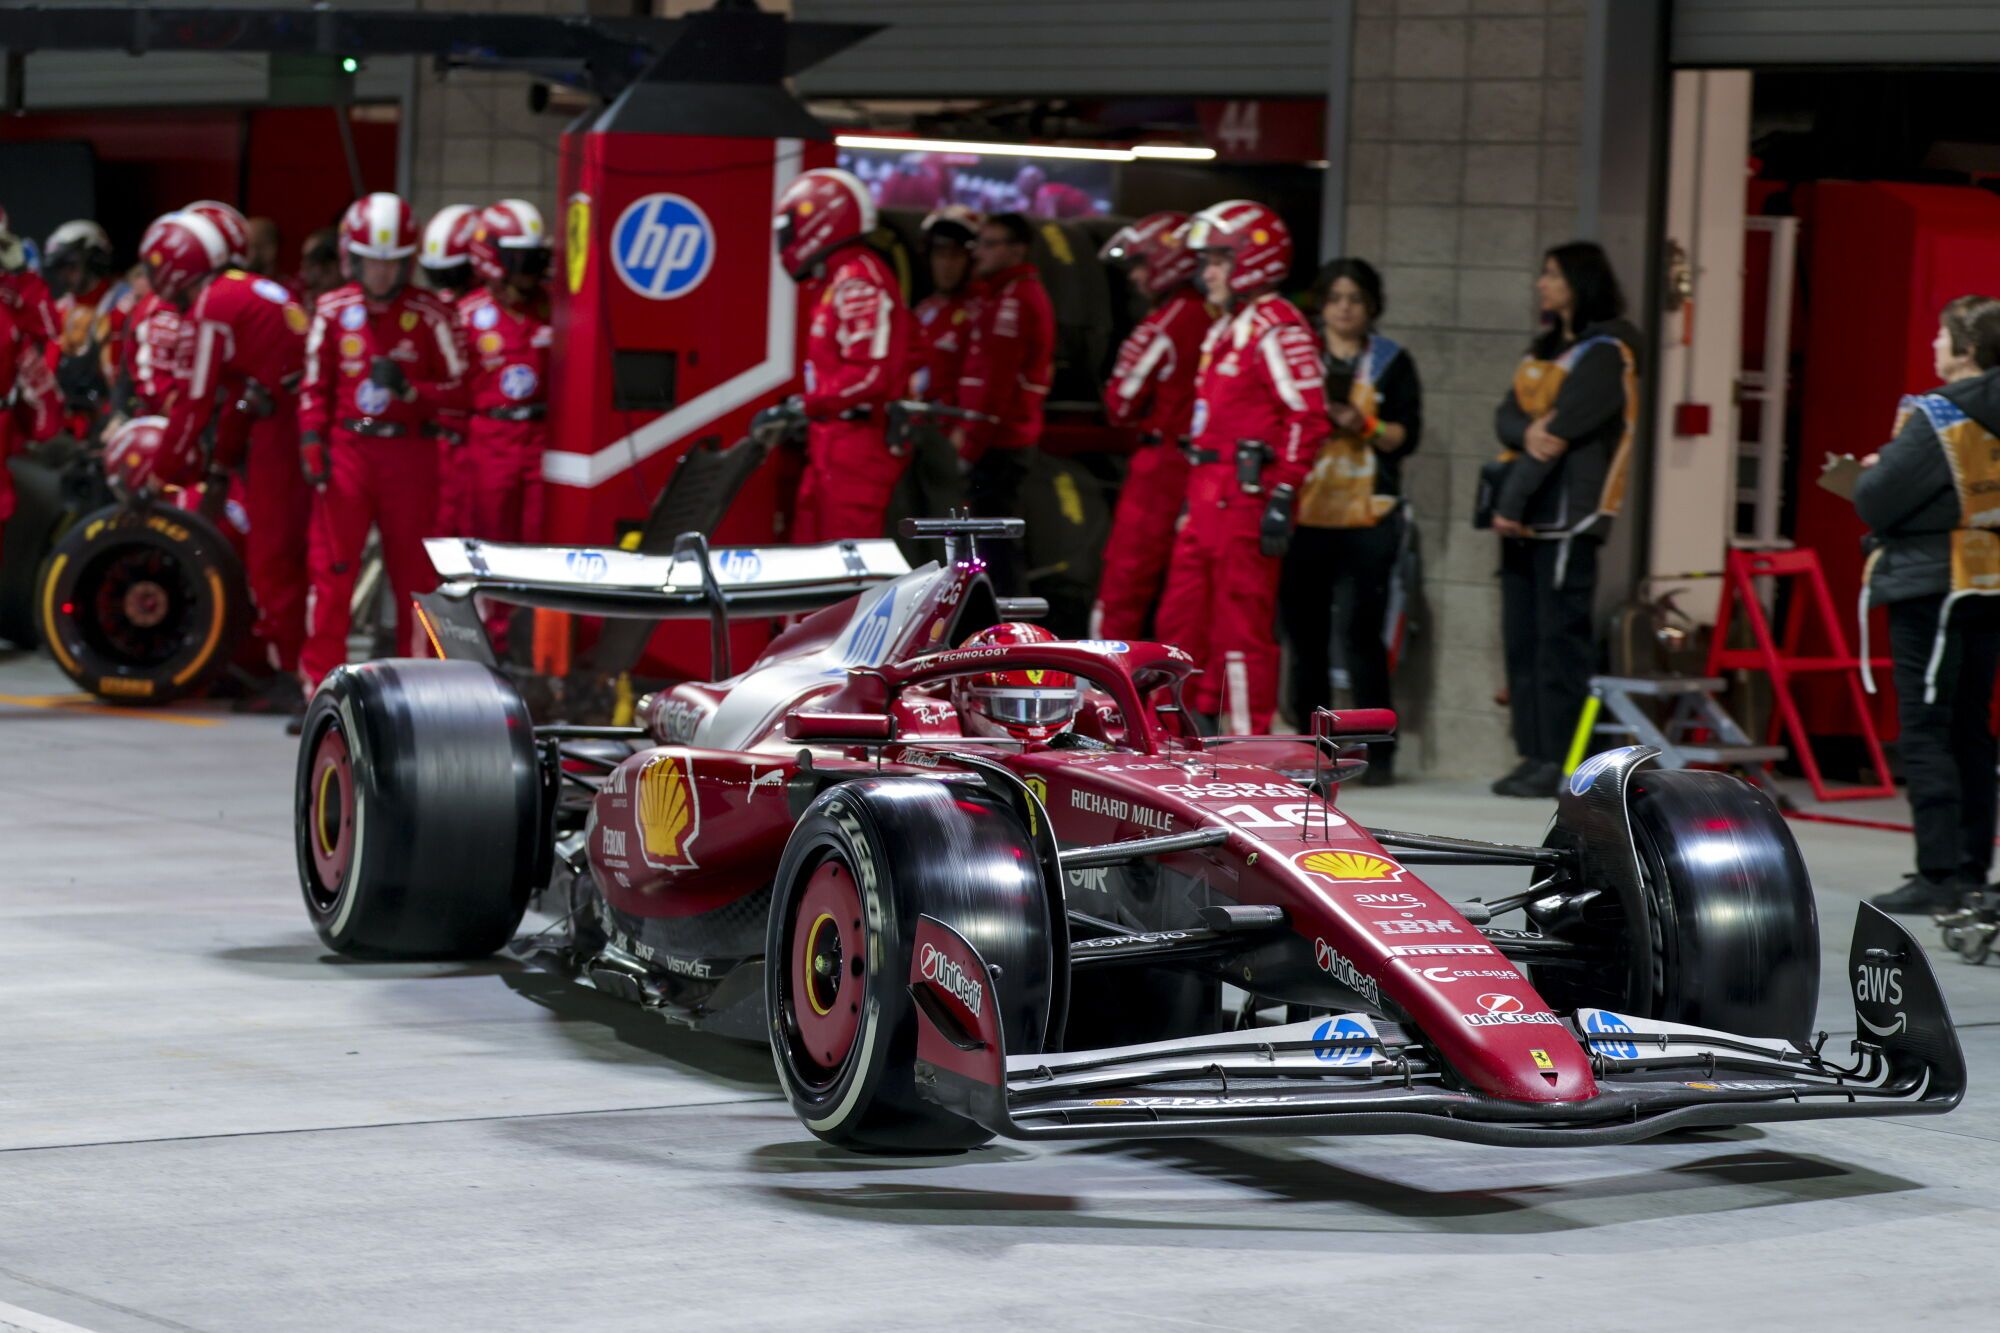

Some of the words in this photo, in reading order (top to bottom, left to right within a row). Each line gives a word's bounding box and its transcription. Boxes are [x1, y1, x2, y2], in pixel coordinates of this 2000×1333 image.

[1218, 101, 1260, 151] 44
[622, 194, 704, 298] hp
[569, 551, 606, 581] hp
[722, 551, 760, 581] hp
[938, 647, 1009, 663] TECHNOLOGY
[913, 706, 958, 725] Ray-Ban
[1156, 782, 1309, 792] GLOBAL
[1182, 789, 1313, 798] POKER
[1071, 789, 1128, 821] RICHARD
[1131, 805, 1174, 832] MILLE
[1219, 804, 1347, 828] 16
[602, 825, 626, 857] PERONI
[1372, 919, 1463, 935] IBM
[635, 940, 655, 961] SKF
[1389, 944, 1495, 956] PIRELLI
[936, 952, 982, 1017] UniCredit
[1328, 945, 1380, 1007] UniCredit
[1452, 970, 1518, 978] CELSIUS
[1857, 964, 1903, 1006] aws
[1463, 1011, 1562, 1026] UniCredit
[1316, 1018, 1369, 1065] hp
[1591, 1010, 1633, 1059] hp
[1132, 1095, 1297, 1107] V-Power
